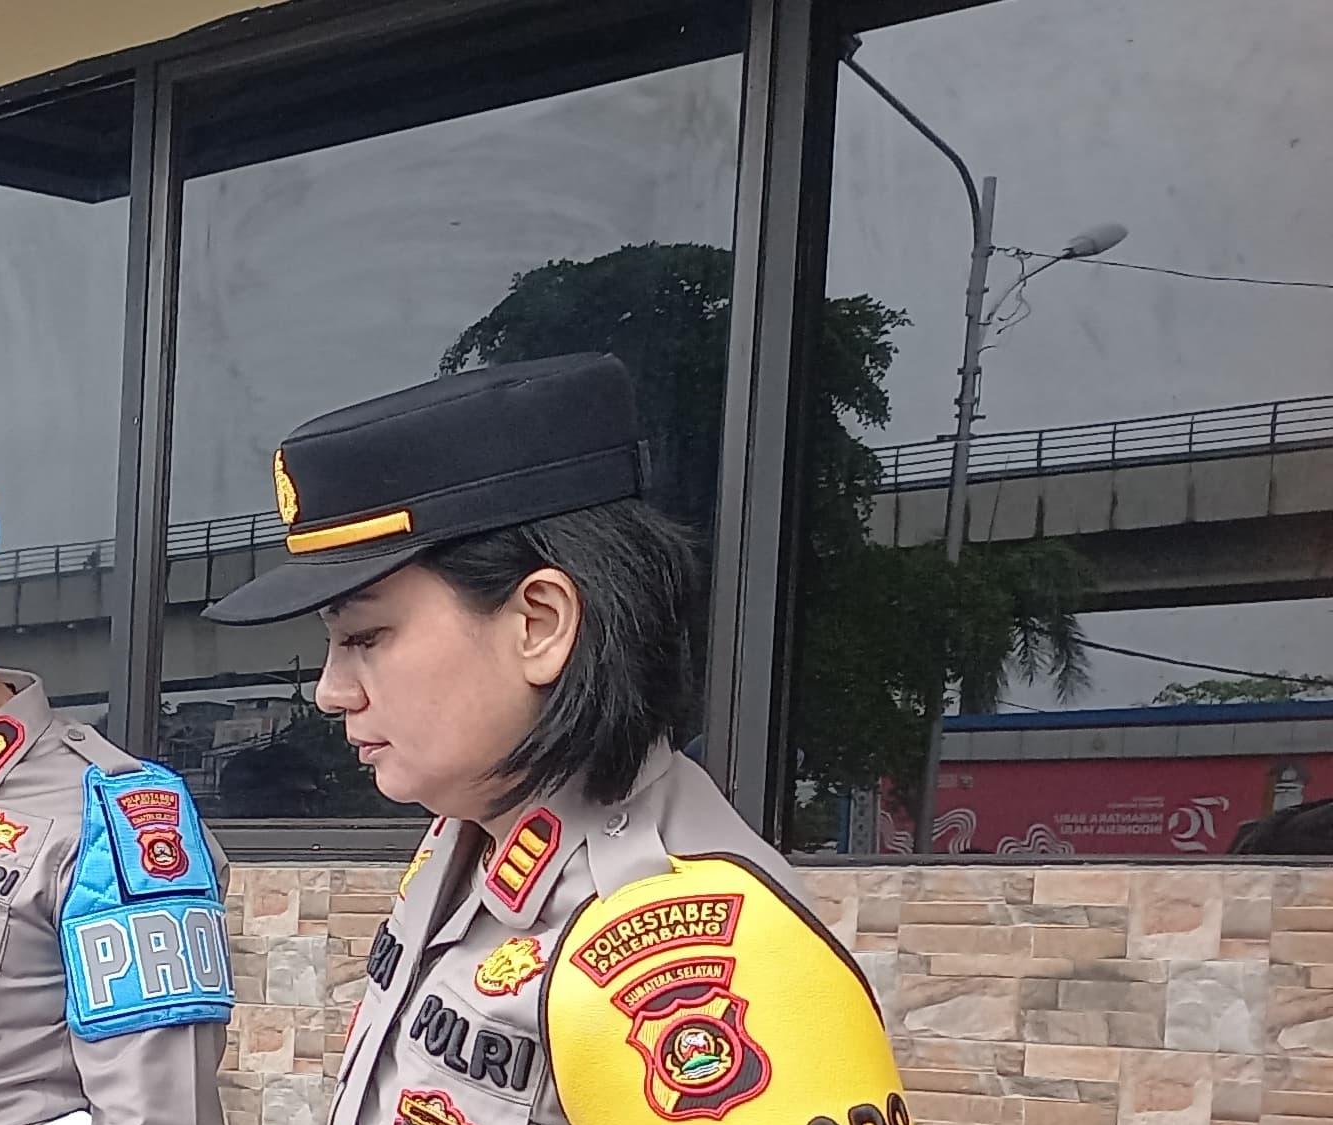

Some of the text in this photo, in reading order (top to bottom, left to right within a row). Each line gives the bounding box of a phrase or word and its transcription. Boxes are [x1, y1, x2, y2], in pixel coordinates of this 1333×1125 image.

[582, 902, 729, 967] POLRESTABES
[597, 922, 721, 974] PALEMBANG
[624, 965, 723, 1007] SUMATERA SELATAN
[409, 994, 534, 1091] POLRI
